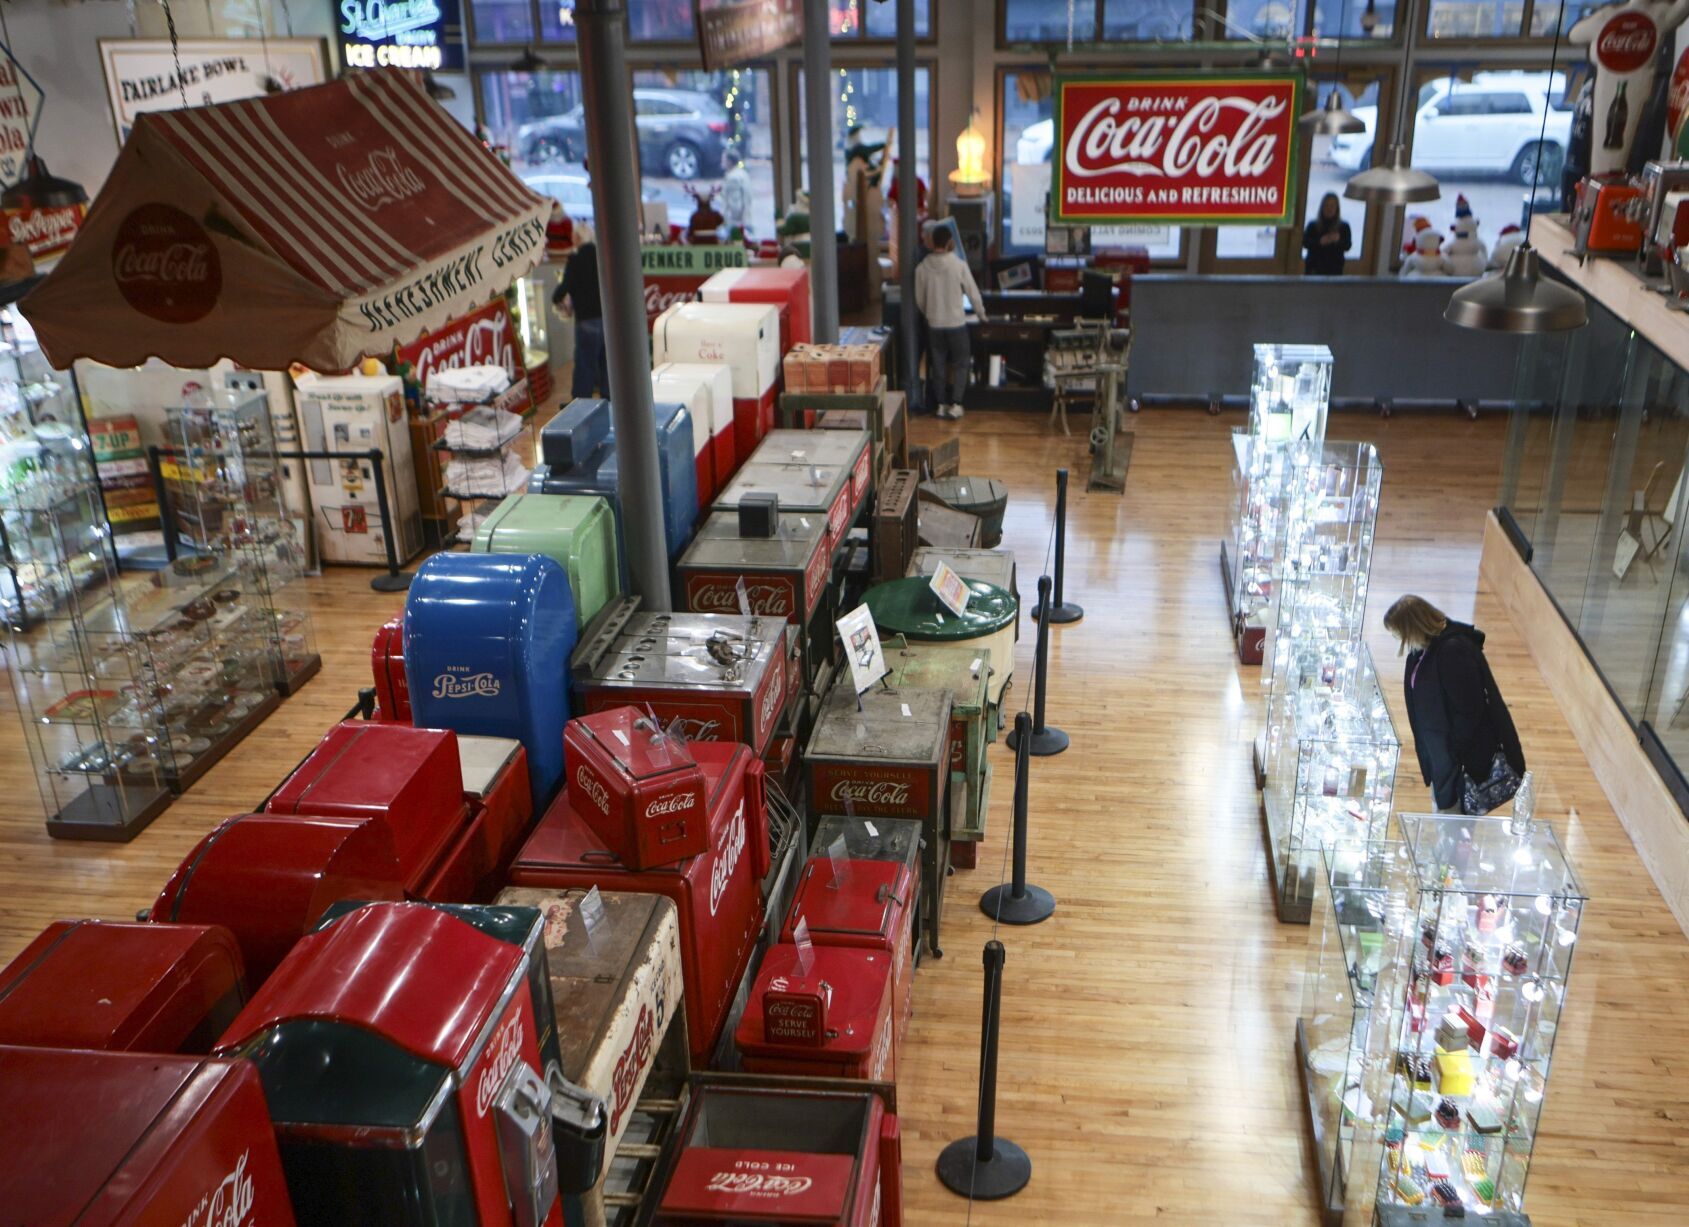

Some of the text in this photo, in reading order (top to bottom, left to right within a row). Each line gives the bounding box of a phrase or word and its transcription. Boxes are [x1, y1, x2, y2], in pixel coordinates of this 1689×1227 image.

[345, 43, 441, 69] ICE CREAM
[121, 56, 249, 102] FAIRLANE BOWL
[1127, 96, 1189, 111] DRINK
[1066, 96, 1287, 178] Coca-Cola
[335, 145, 426, 212] Coca-Cola
[1066, 186, 1278, 205] DELICIOUS AND REFRESHING
[115, 243, 209, 283] Coca-Cola
[703, 250, 744, 269] DRUG
[360, 216, 545, 333] REFRESHMENT CENTER
[433, 330, 464, 356] DRINK
[698, 349, 725, 360] Coke
[692, 583, 789, 614] CocaCola
[447, 664, 471, 673] DRINK
[645, 791, 696, 819] Coca-Cola
[830, 779, 912, 805] Coca-Cola
[710, 796, 746, 917] Coca-Cola
[770, 1026, 816, 1038] YOURSELF
[778, 1019, 807, 1028] SERVE
[485, 1023, 505, 1059] DRINK
[477, 1006, 524, 1119] Coca-Cola
[734, 1160, 795, 1172] ICE COLD
[704, 1171, 813, 1196] Coca-Cola
